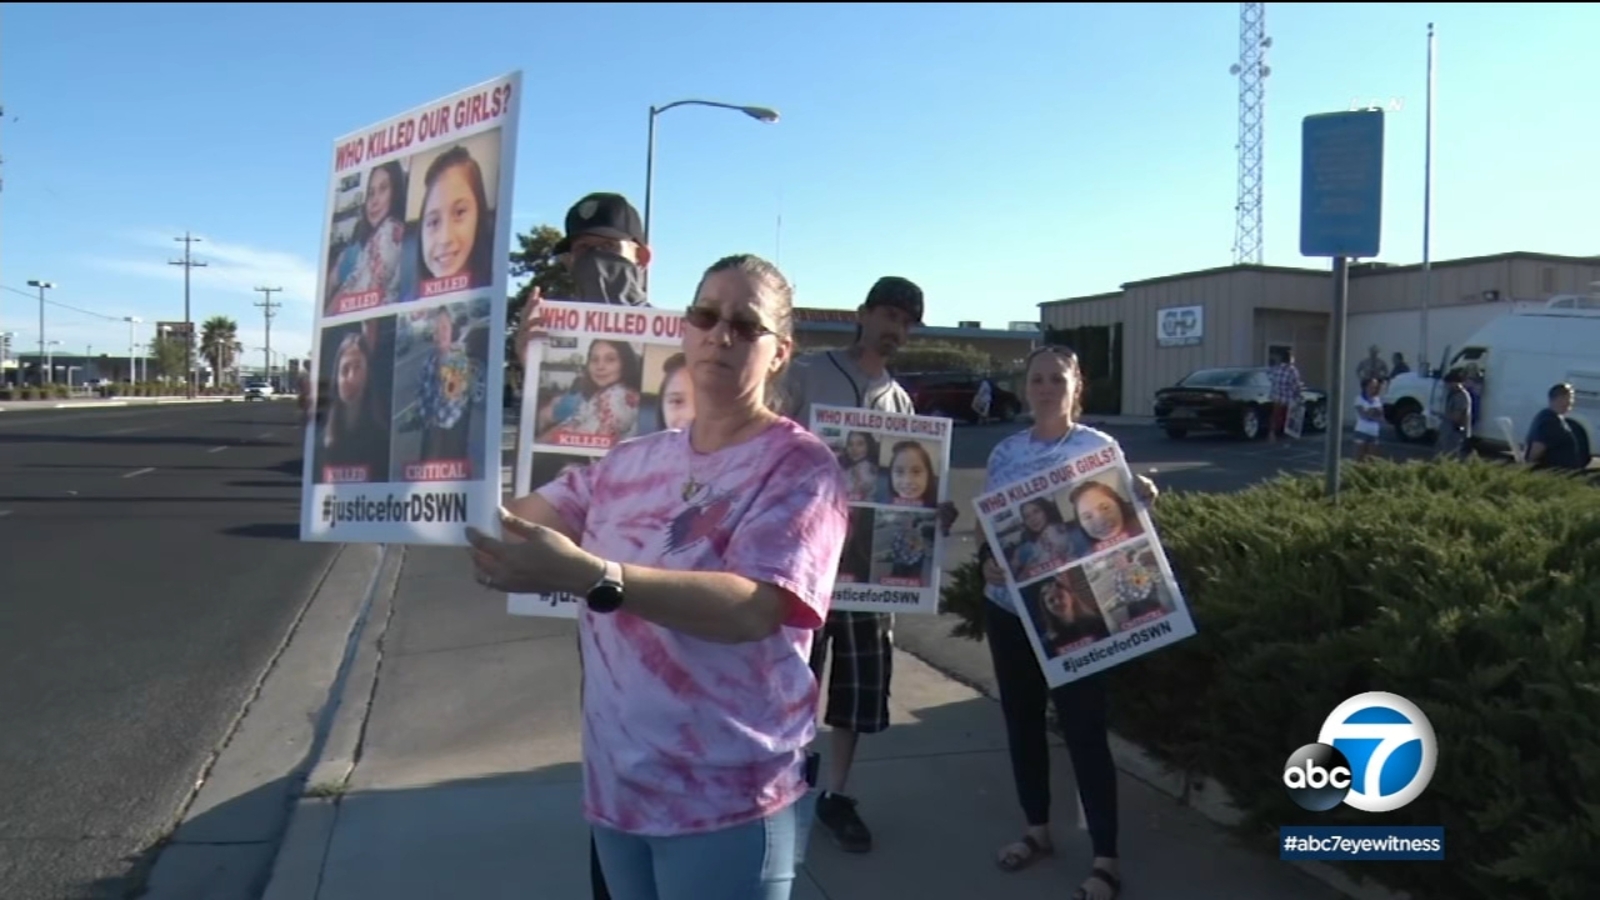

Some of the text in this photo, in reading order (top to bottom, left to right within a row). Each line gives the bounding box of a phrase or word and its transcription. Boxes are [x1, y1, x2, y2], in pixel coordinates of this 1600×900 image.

[335, 83, 511, 172] WHO KILLED OUR GIRLS?
[425, 276, 468, 296] KILLED
[340, 292, 379, 312] KILLED
[539, 308, 580, 330] WHO
[584, 311, 646, 335] KILLED
[816, 409, 947, 436] WHO KILLED OUR GIRLS?
[559, 433, 611, 447] KILLED
[405, 462, 467, 480] CRITICAL
[979, 447, 1116, 514] WHO KILLED OUR GIRLS?
[322, 493, 467, 528] #justiceforDSWN
[1061, 620, 1172, 673] #justiceforDSWN
